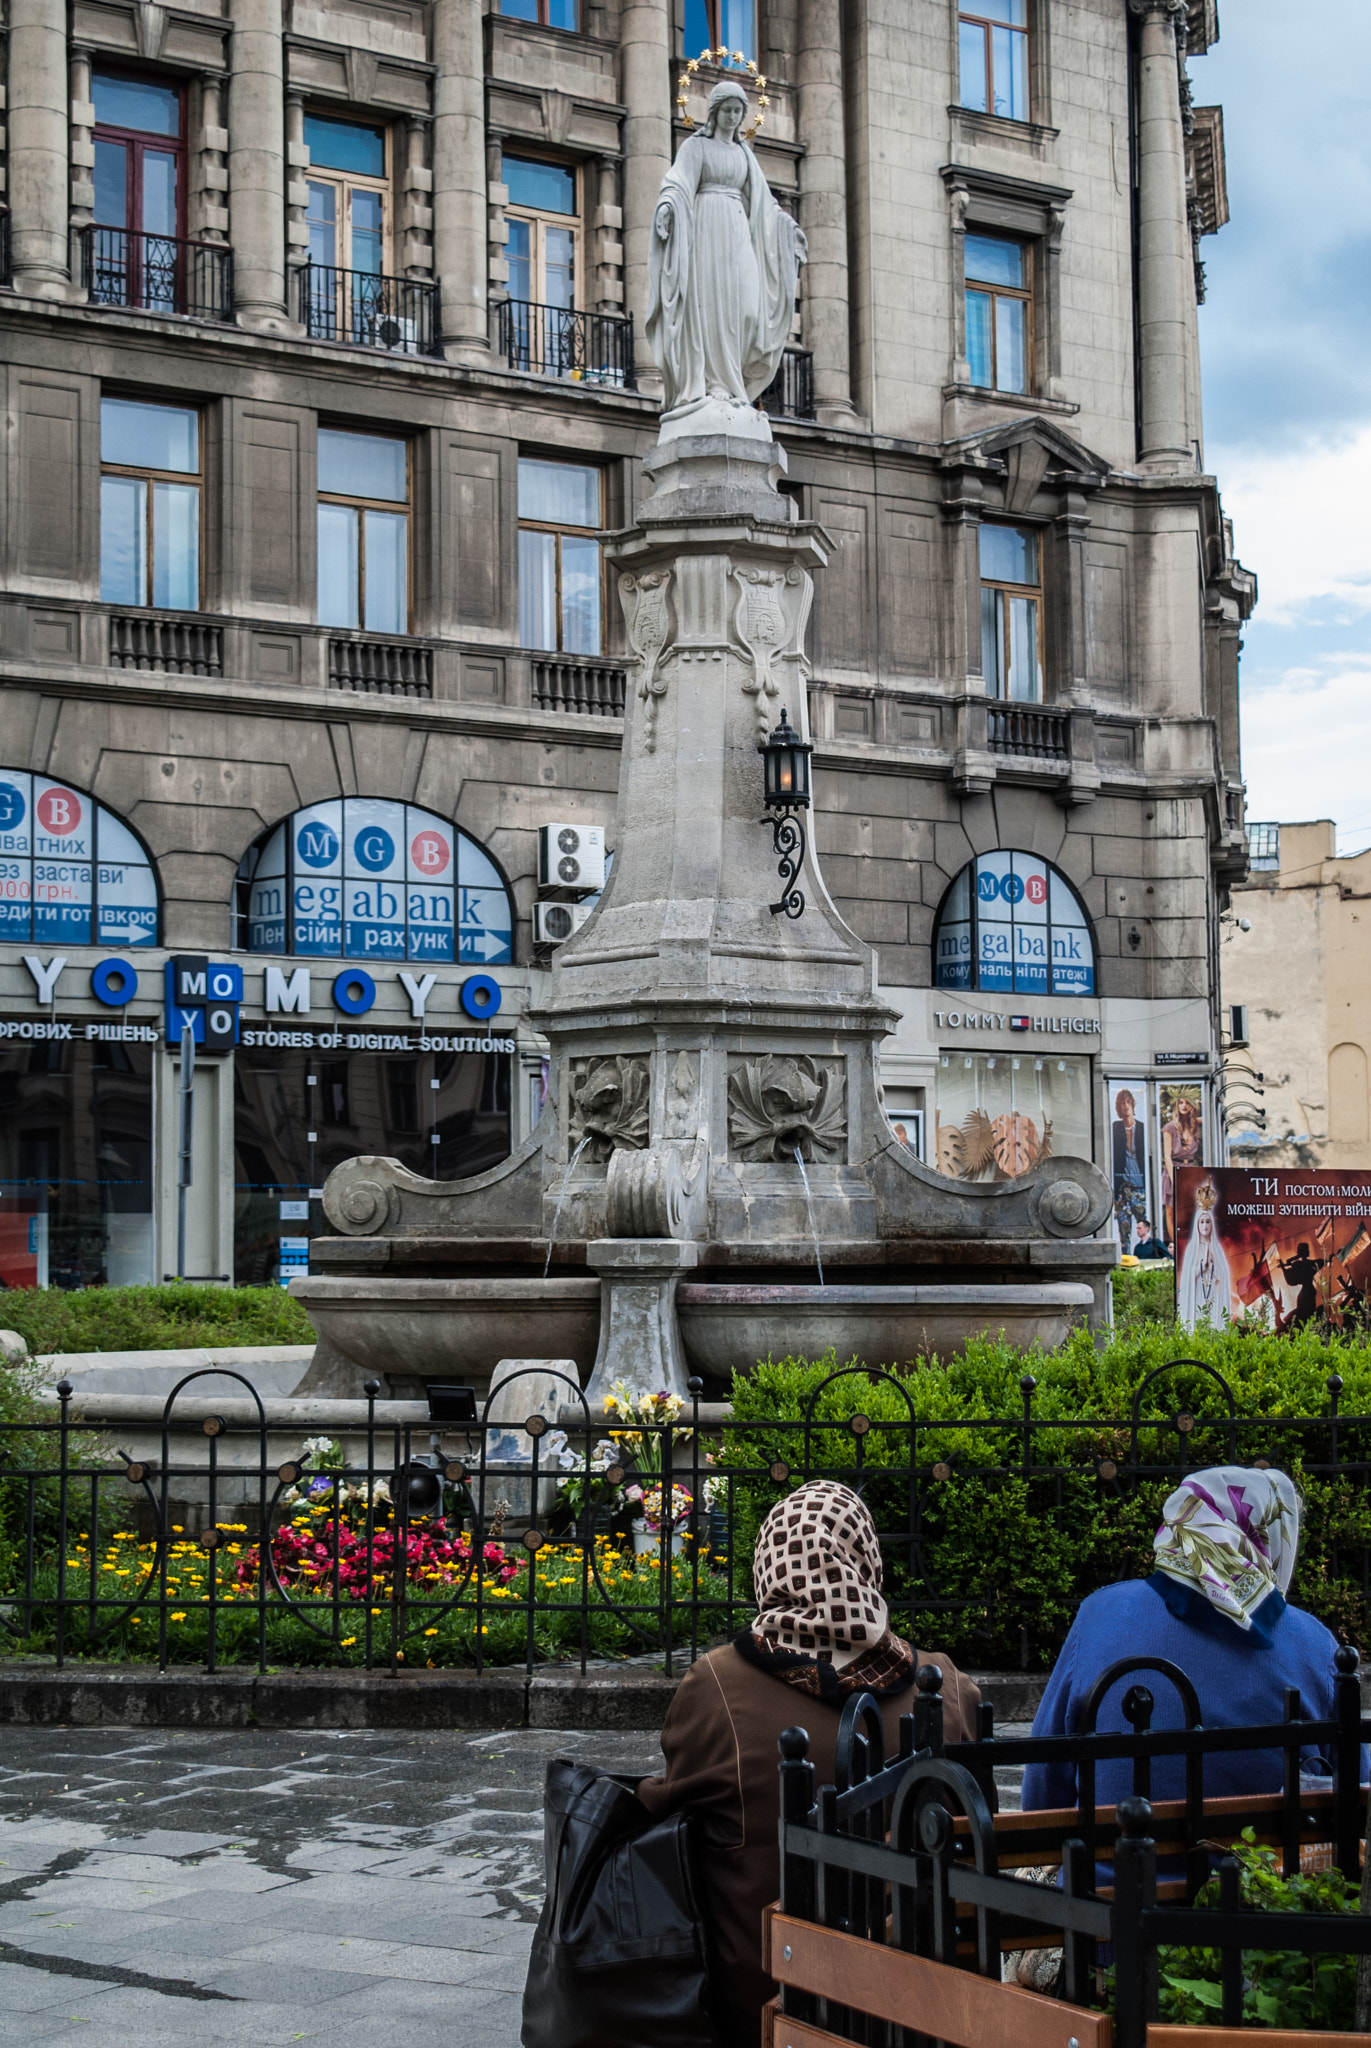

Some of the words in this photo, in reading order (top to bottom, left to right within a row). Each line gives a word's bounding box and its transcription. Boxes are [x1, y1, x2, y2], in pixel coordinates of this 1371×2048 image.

[0, 834, 85, 855] ватних
[37, 884, 79, 903] грн.
[257, 882, 483, 925] megabank
[61, 906, 157, 925] готівкою
[253, 919, 352, 946] Пенсійні
[364, 928, 475, 952] рахунки
[940, 929, 1082, 960] megabank
[942, 964, 1029, 979] Комунальні
[1030, 967, 1087, 981] платежі
[265, 966, 502, 1020] MOYO
[86, 1024, 159, 1043] РІШЕНЬ
[935, 1012, 1006, 1030] TOMMY
[1033, 1016, 1101, 1034] HILFIGER
[243, 1030, 314, 1048] STORES
[318, 1034, 343, 1049] OF
[347, 1034, 413, 1050] DIGITAL
[420, 1036, 516, 1054] SOLUTIONS
[1250, 1177, 1279, 1196] ТИ
[1285, 1184, 1335, 1197] ПОСТОМ
[1227, 1203, 1275, 1216] МОЖЕШ
[1278, 1203, 1342, 1216] ЗУПИНИТИ
